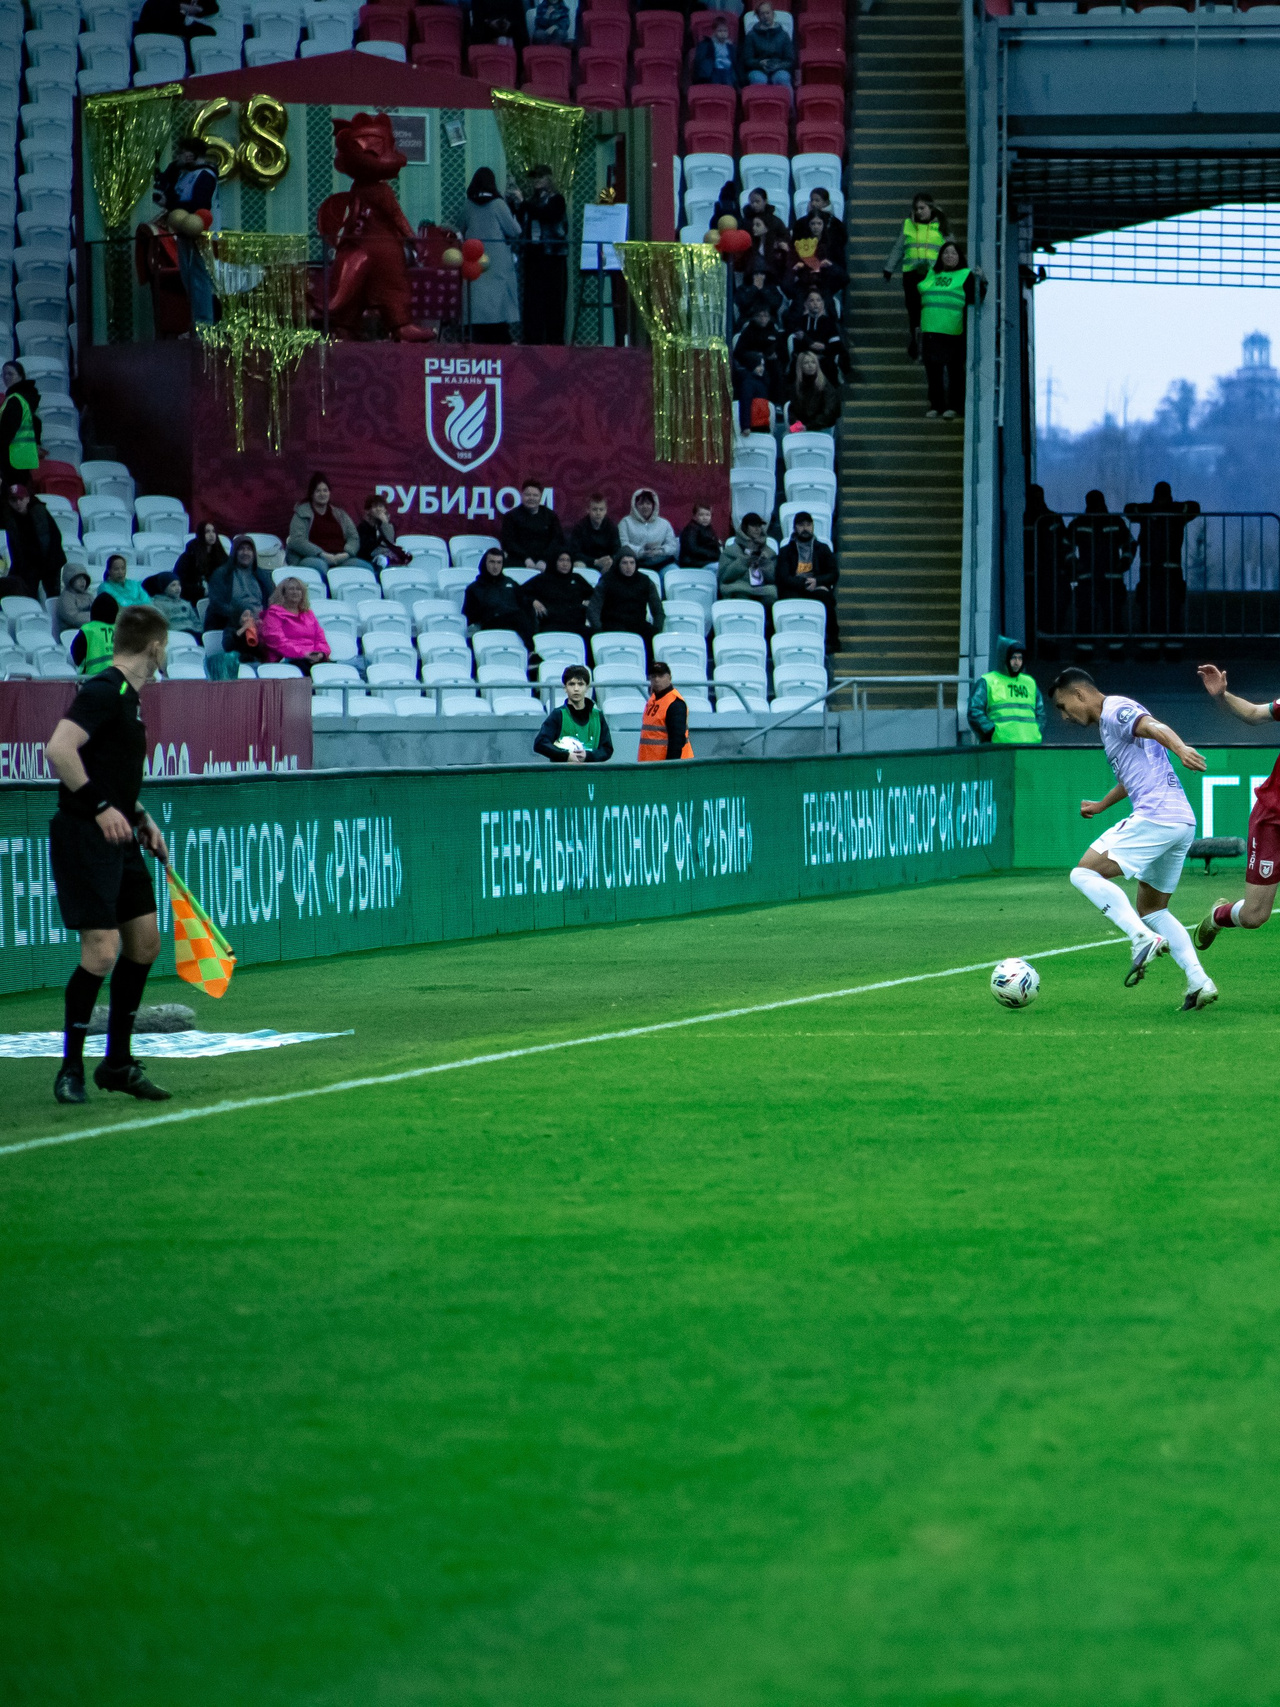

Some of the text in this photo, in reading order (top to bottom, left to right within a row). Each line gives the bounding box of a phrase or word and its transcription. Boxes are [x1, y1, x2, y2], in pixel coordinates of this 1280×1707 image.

[186, 94, 290, 182] 68
[424, 357, 502, 375] РУБИН
[444, 376, 482, 385] КАЗАНЬ
[480, 783, 753, 899] ГЕНЕРАЛЬНЫЙ СПОНСОР ФК «РУБИН»
[803, 768, 998, 867] ГЕНЕРАЛЬНЫЙ СПОНСОР ФК «РУБИН»
[184, 821, 286, 929] СПОНСОР
[291, 819, 321, 920] ФК
[325, 815, 402, 915] «РУБИН»
